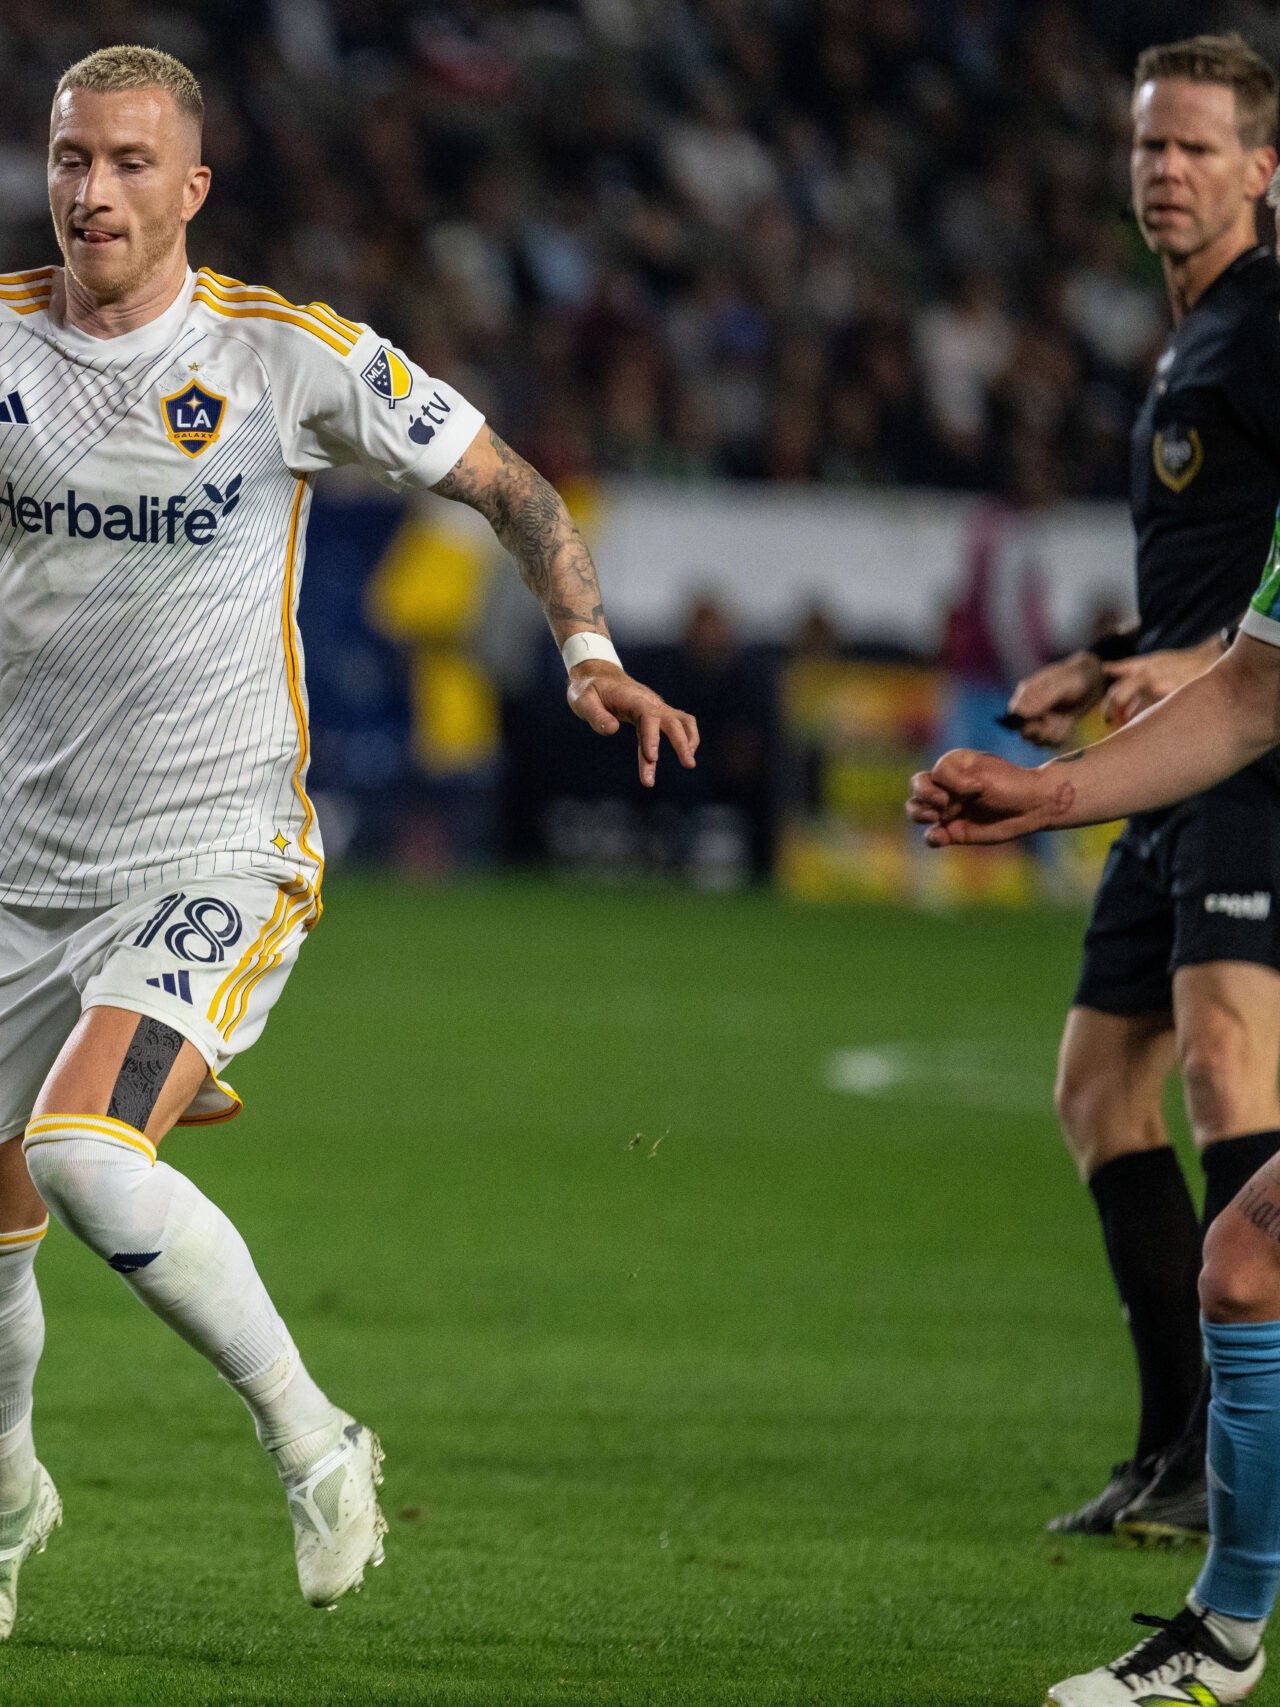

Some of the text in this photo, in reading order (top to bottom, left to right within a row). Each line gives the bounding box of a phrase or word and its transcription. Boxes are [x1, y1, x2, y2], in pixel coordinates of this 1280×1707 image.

[365, 359, 387, 383] MLS
[176, 408, 212, 428] LA
[421, 391, 451, 425] tv
[133, 891, 243, 963] 18
